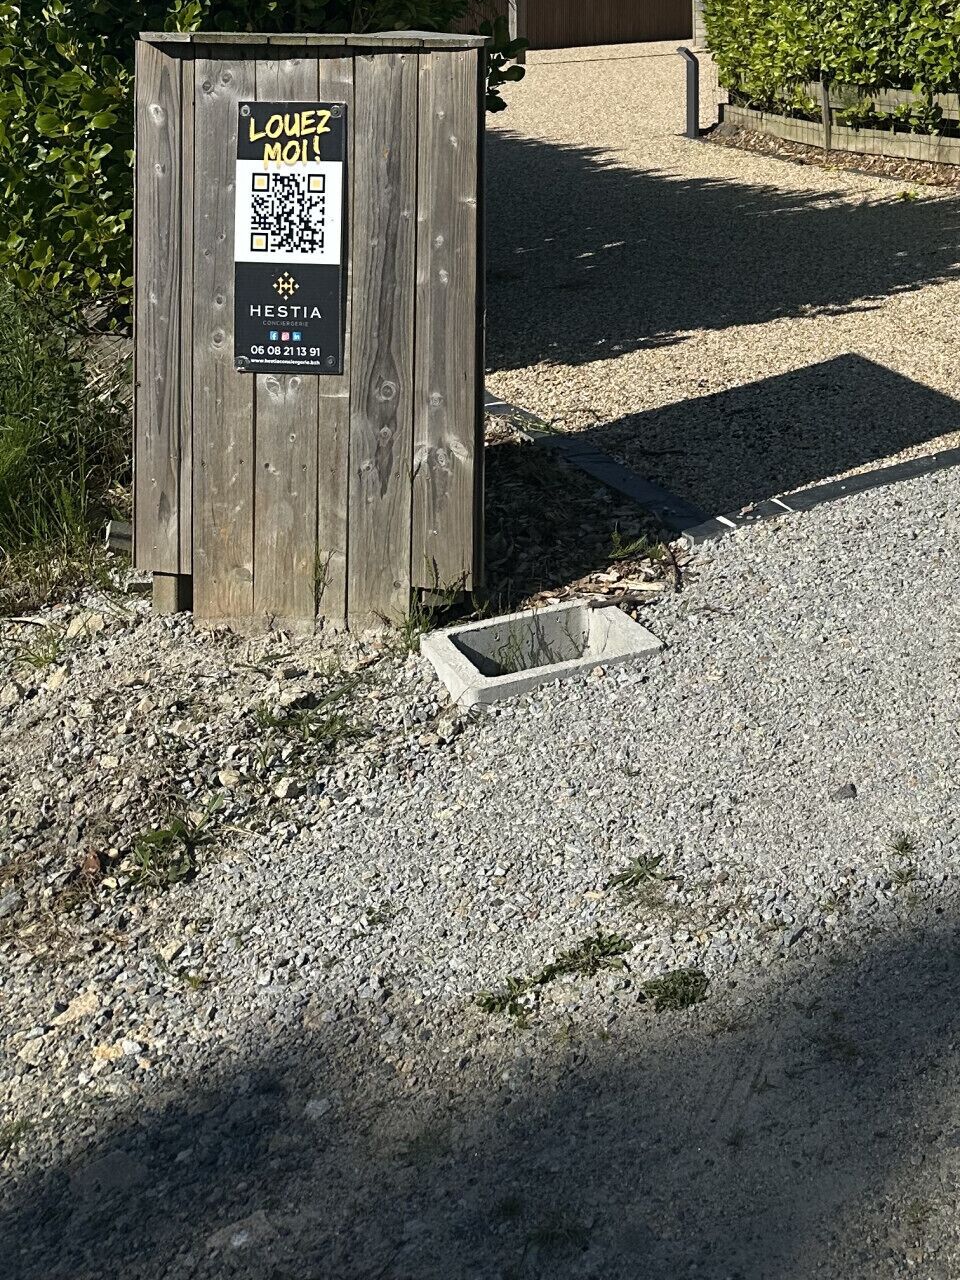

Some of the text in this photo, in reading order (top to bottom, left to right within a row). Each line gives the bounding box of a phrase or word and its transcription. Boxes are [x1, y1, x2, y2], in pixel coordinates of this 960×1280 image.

[249, 109, 332, 142] LOUEZ
[250, 304, 322, 319] HESTIA
[250, 345, 321, 357] 06 08 21 13 91
